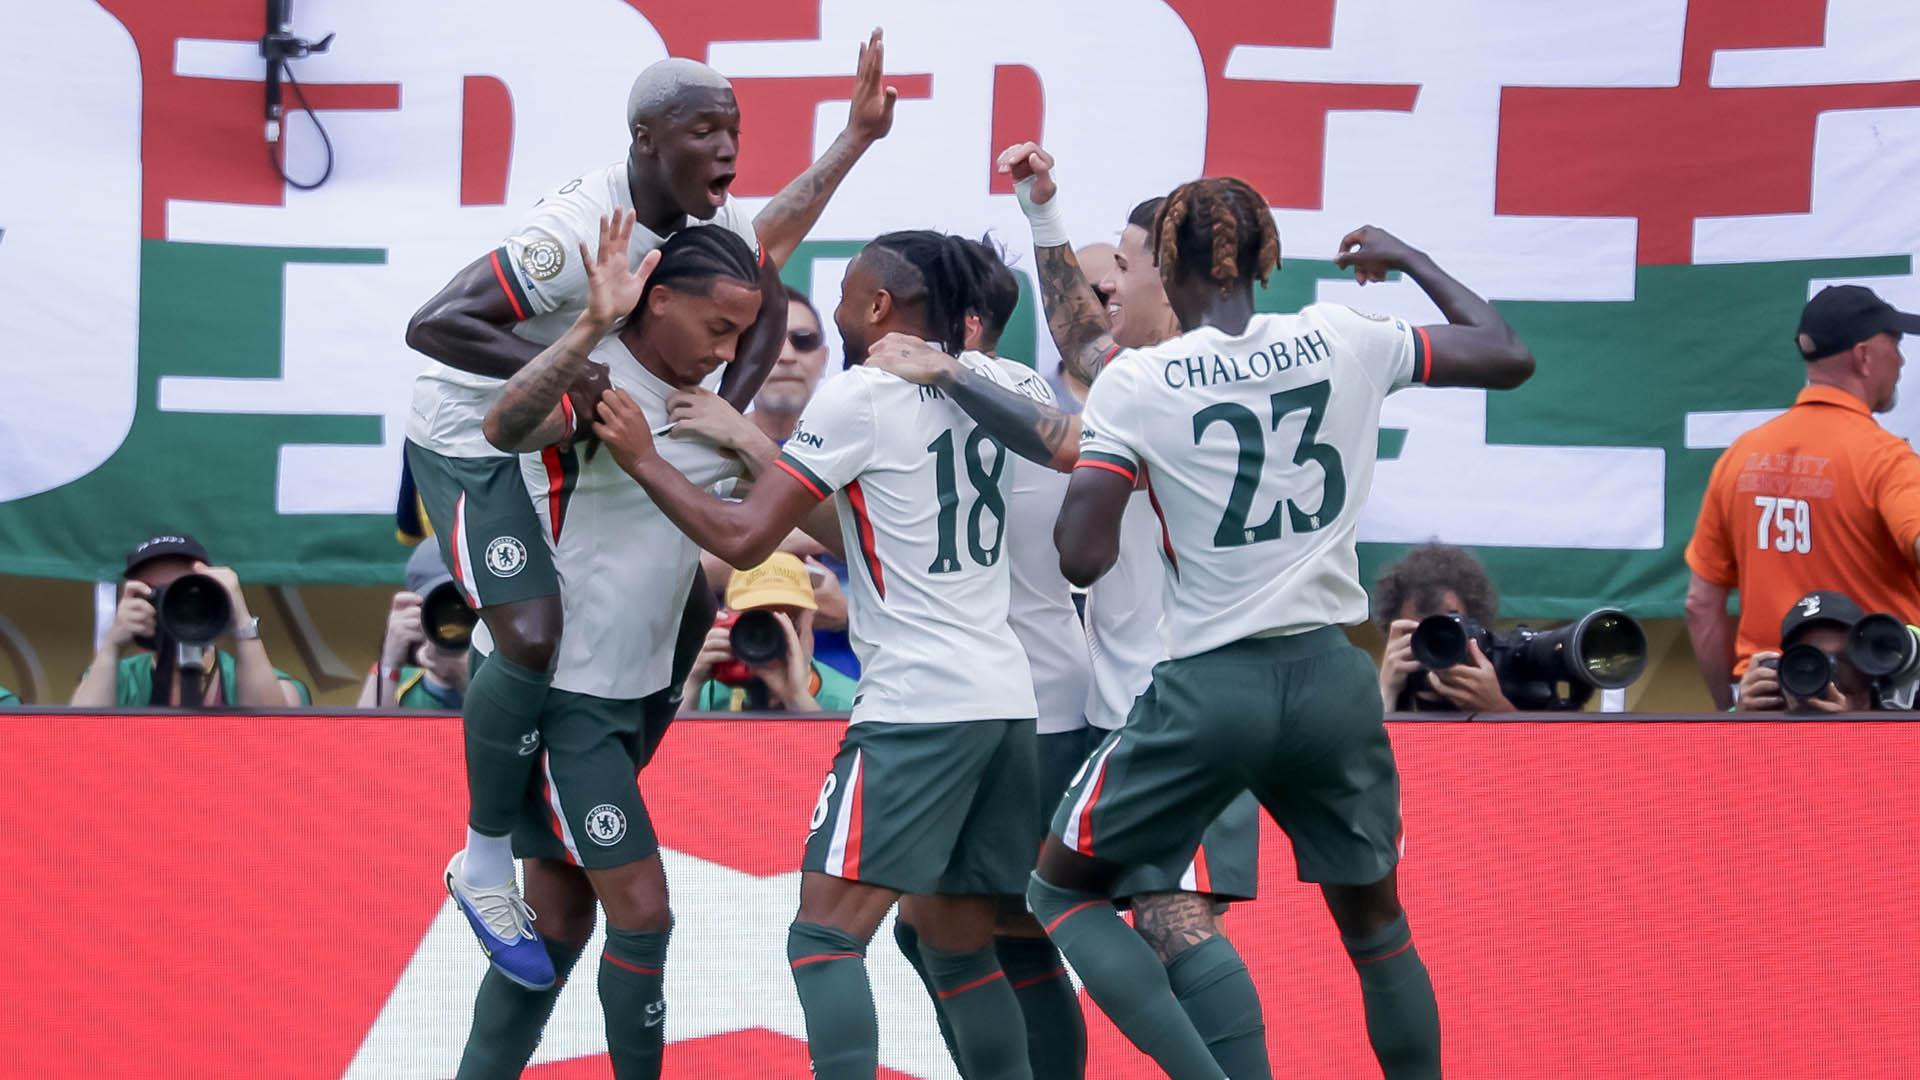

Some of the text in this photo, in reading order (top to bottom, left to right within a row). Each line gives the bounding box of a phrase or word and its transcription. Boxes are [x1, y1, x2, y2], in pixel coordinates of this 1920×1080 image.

[1164, 328, 1332, 390] CHALOBAH
[927, 425, 1006, 574] 18
[1192, 379, 1346, 548] 23
[1754, 495, 1812, 554] 759
